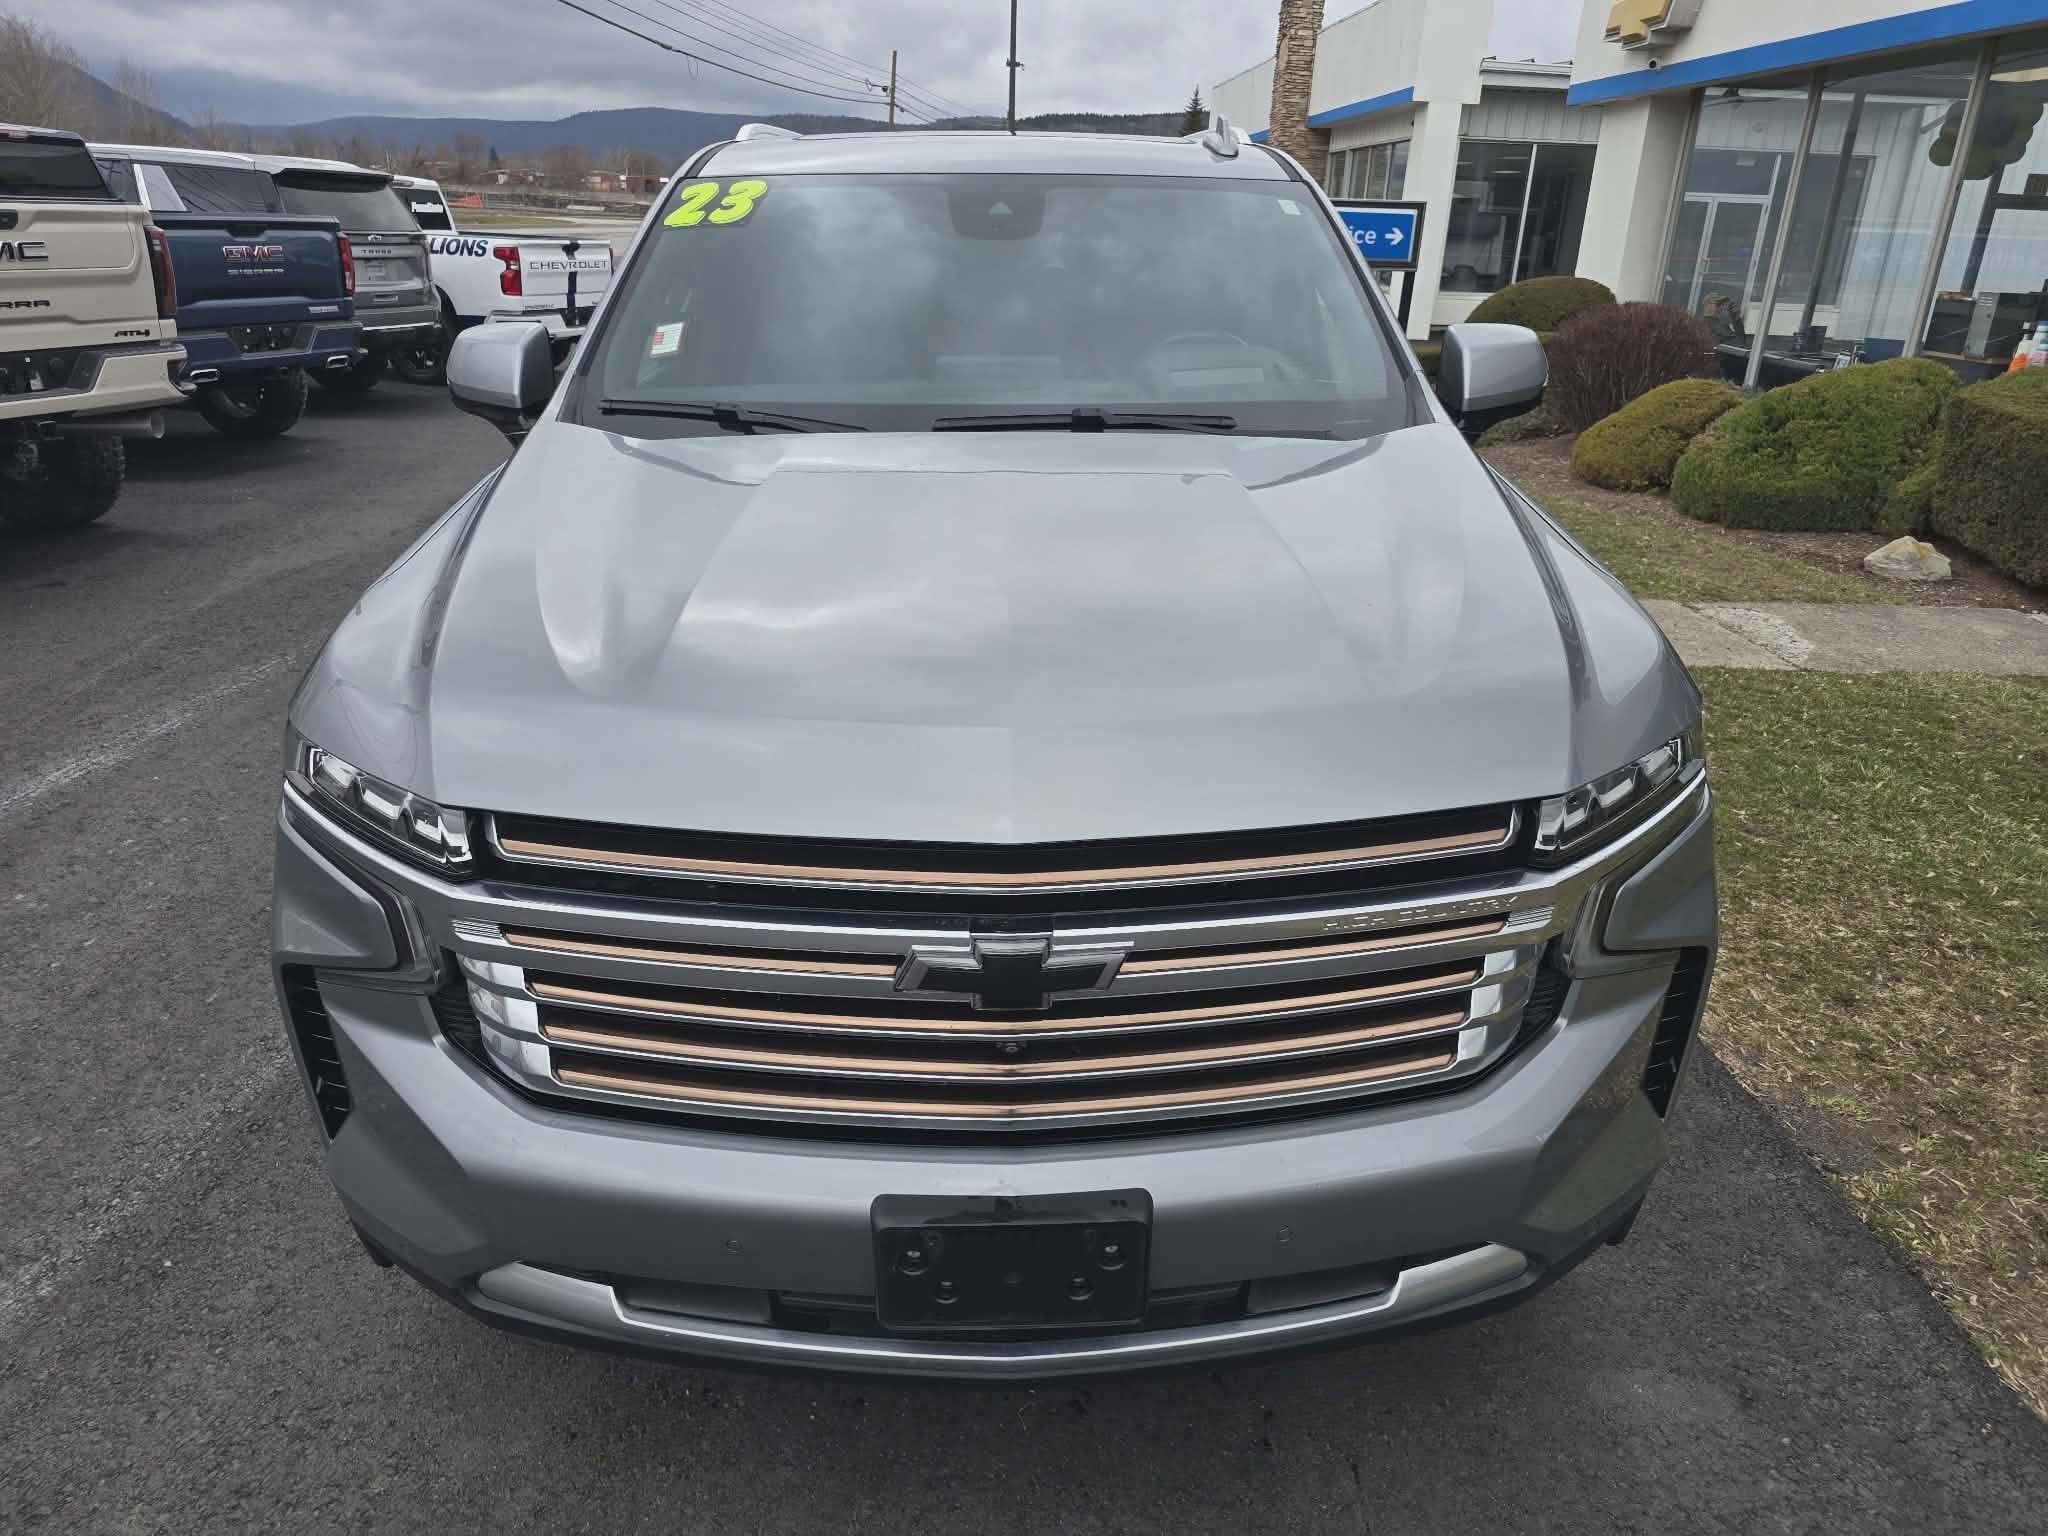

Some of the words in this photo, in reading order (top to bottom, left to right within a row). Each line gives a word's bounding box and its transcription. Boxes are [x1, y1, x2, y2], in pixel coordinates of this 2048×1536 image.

[663, 180, 767, 227] 23
[222, 245, 283, 260] GMC
[430, 237, 489, 257] LIONS
[529, 260, 608, 270] CHEVROLET
